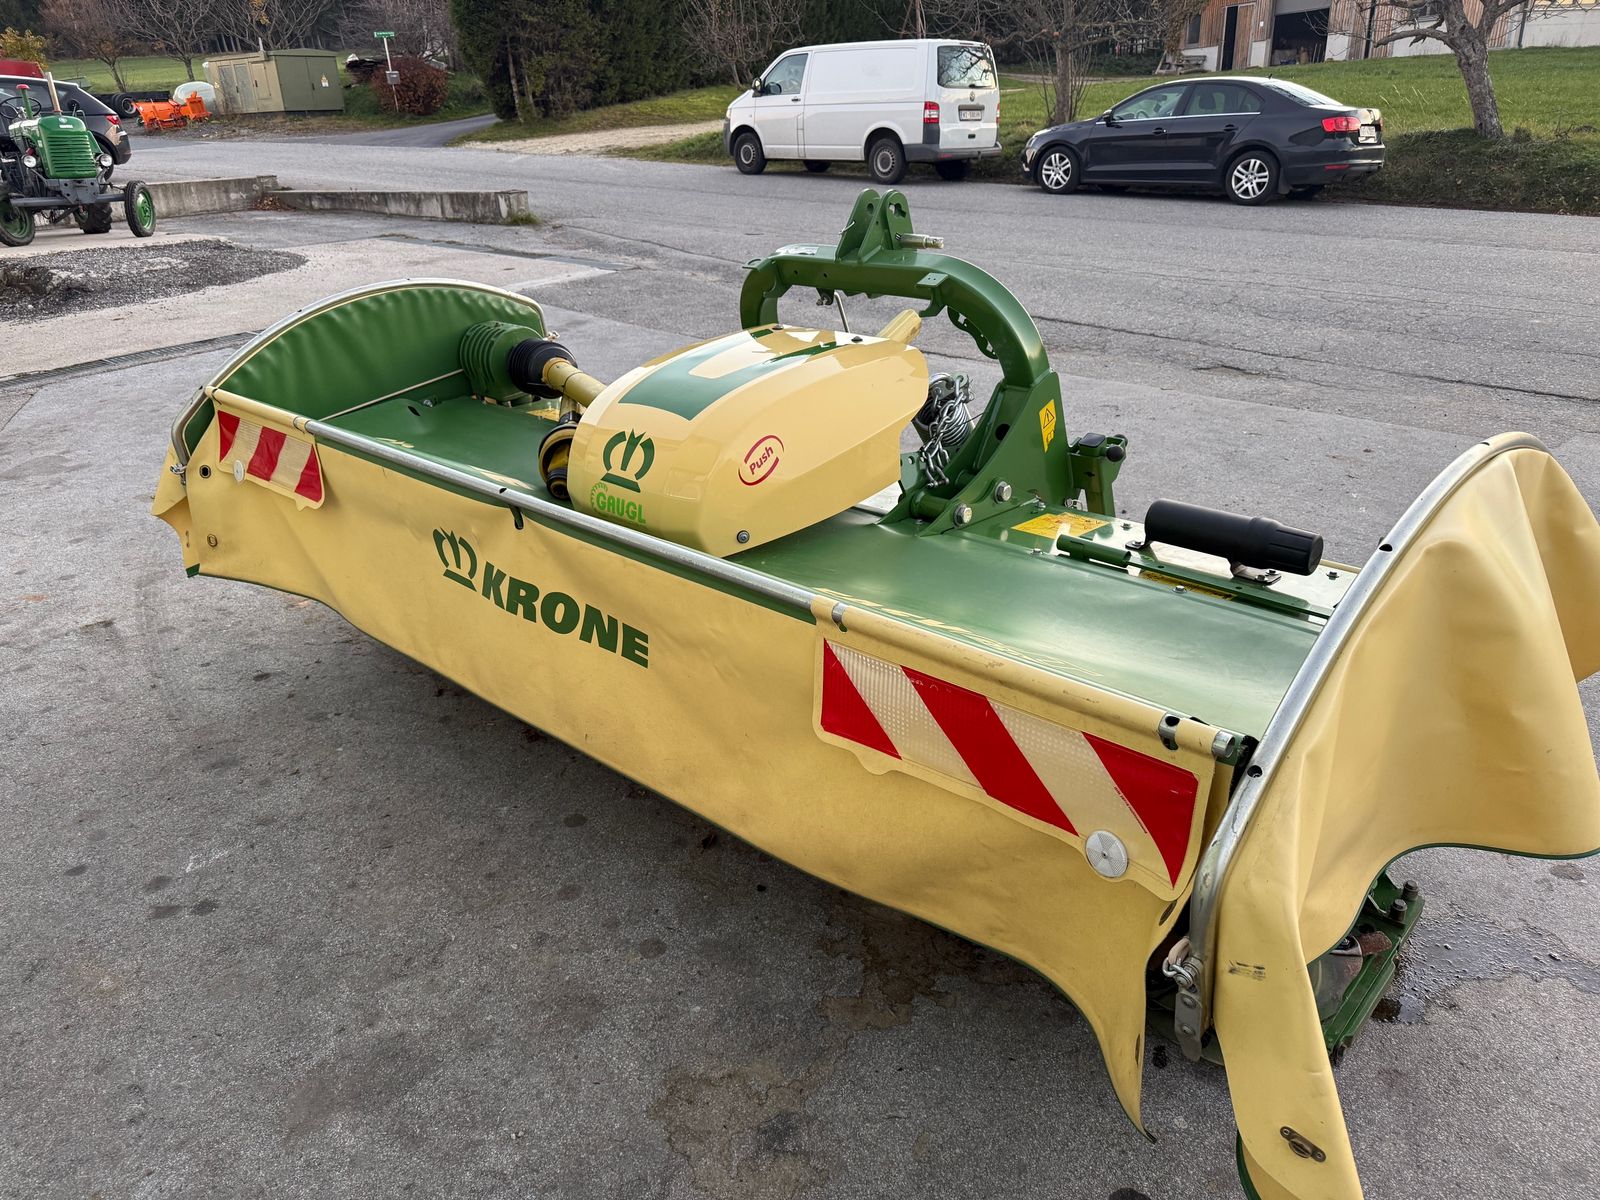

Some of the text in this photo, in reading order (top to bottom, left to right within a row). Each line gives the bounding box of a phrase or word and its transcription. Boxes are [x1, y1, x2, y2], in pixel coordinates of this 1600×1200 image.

[748, 444, 774, 476] Push
[596, 492, 646, 524] GAUGL
[481, 561, 649, 669] KRONE
